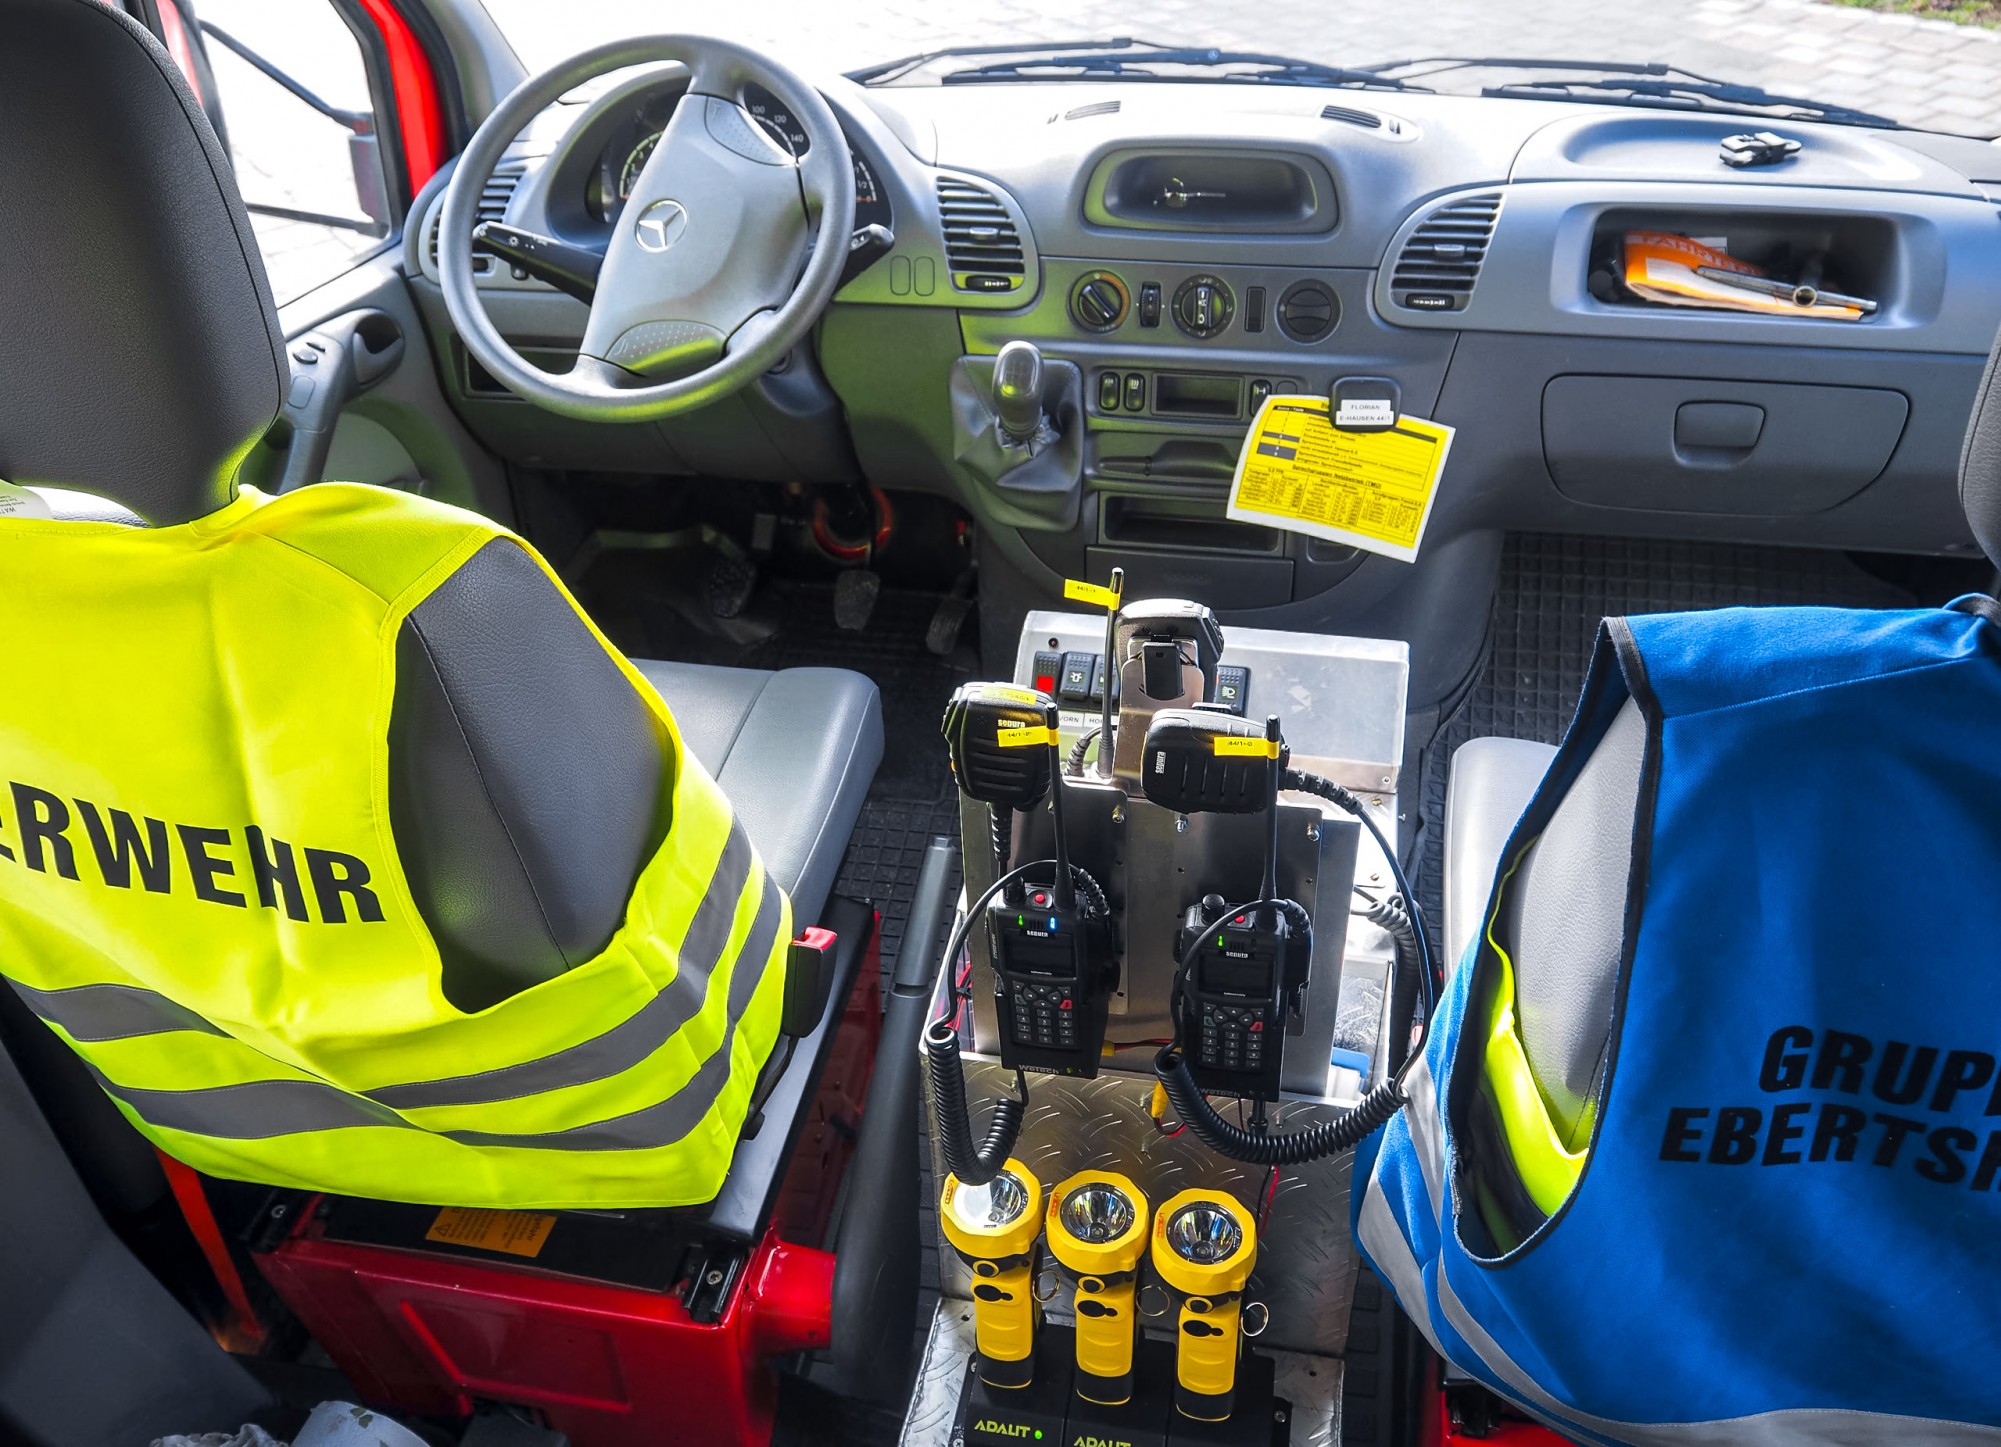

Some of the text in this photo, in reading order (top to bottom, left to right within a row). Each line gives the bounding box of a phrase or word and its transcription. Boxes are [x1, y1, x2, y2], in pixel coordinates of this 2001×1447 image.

[752, 105, 765, 114] 100
[774, 115, 787, 124] 120
[791, 134, 804, 143] 140
[0, 781, 387, 924] RWEHR
[974, 1419, 1031, 1438] ADALIT
